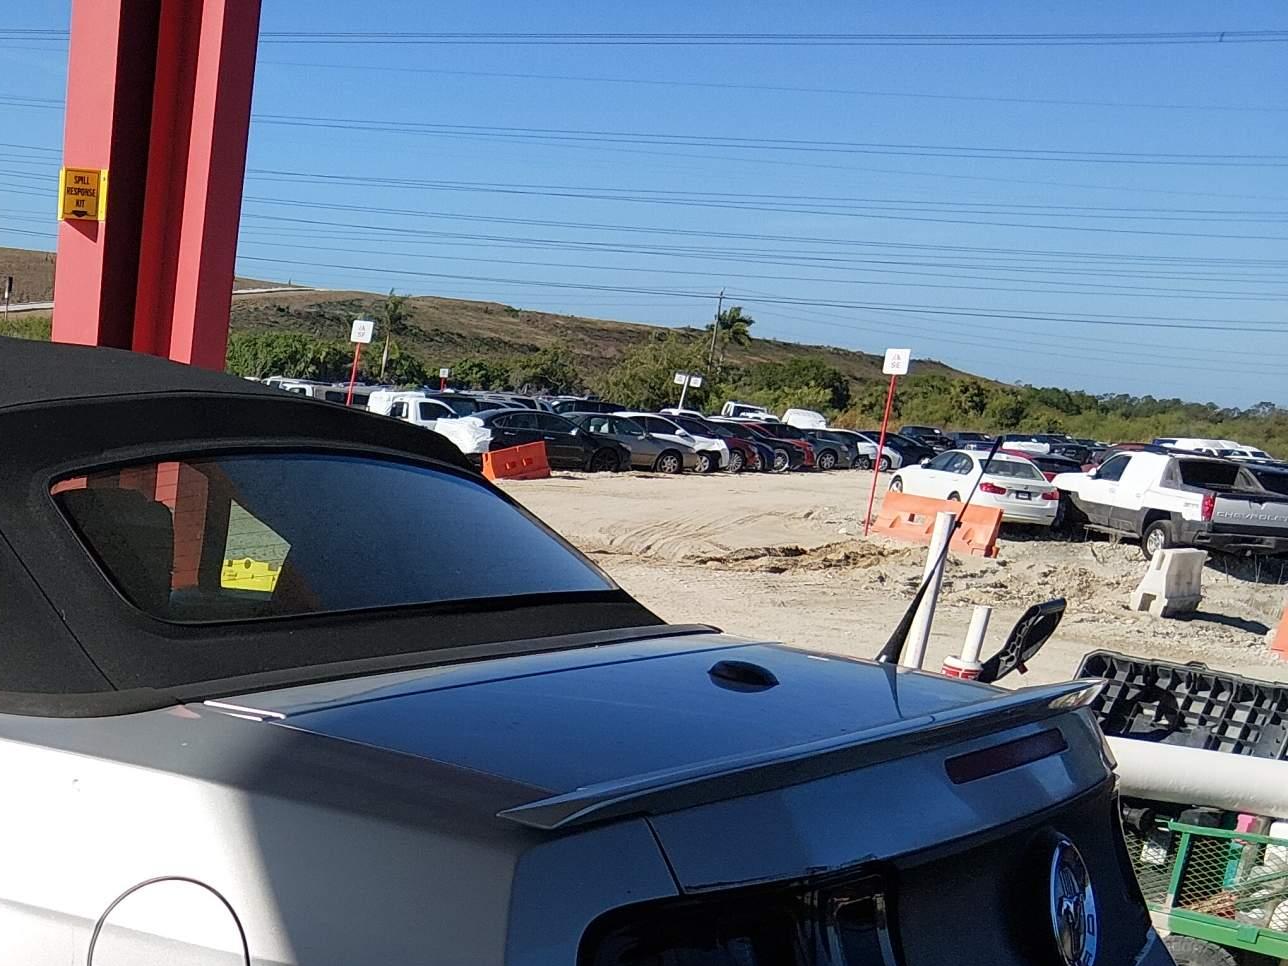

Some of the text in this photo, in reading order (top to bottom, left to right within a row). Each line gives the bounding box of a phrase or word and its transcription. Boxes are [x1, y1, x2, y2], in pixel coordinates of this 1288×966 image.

[73, 175, 90, 185] SPILL
[66, 186, 96, 197] RESPONSE
[75, 199, 85, 208] KIT
